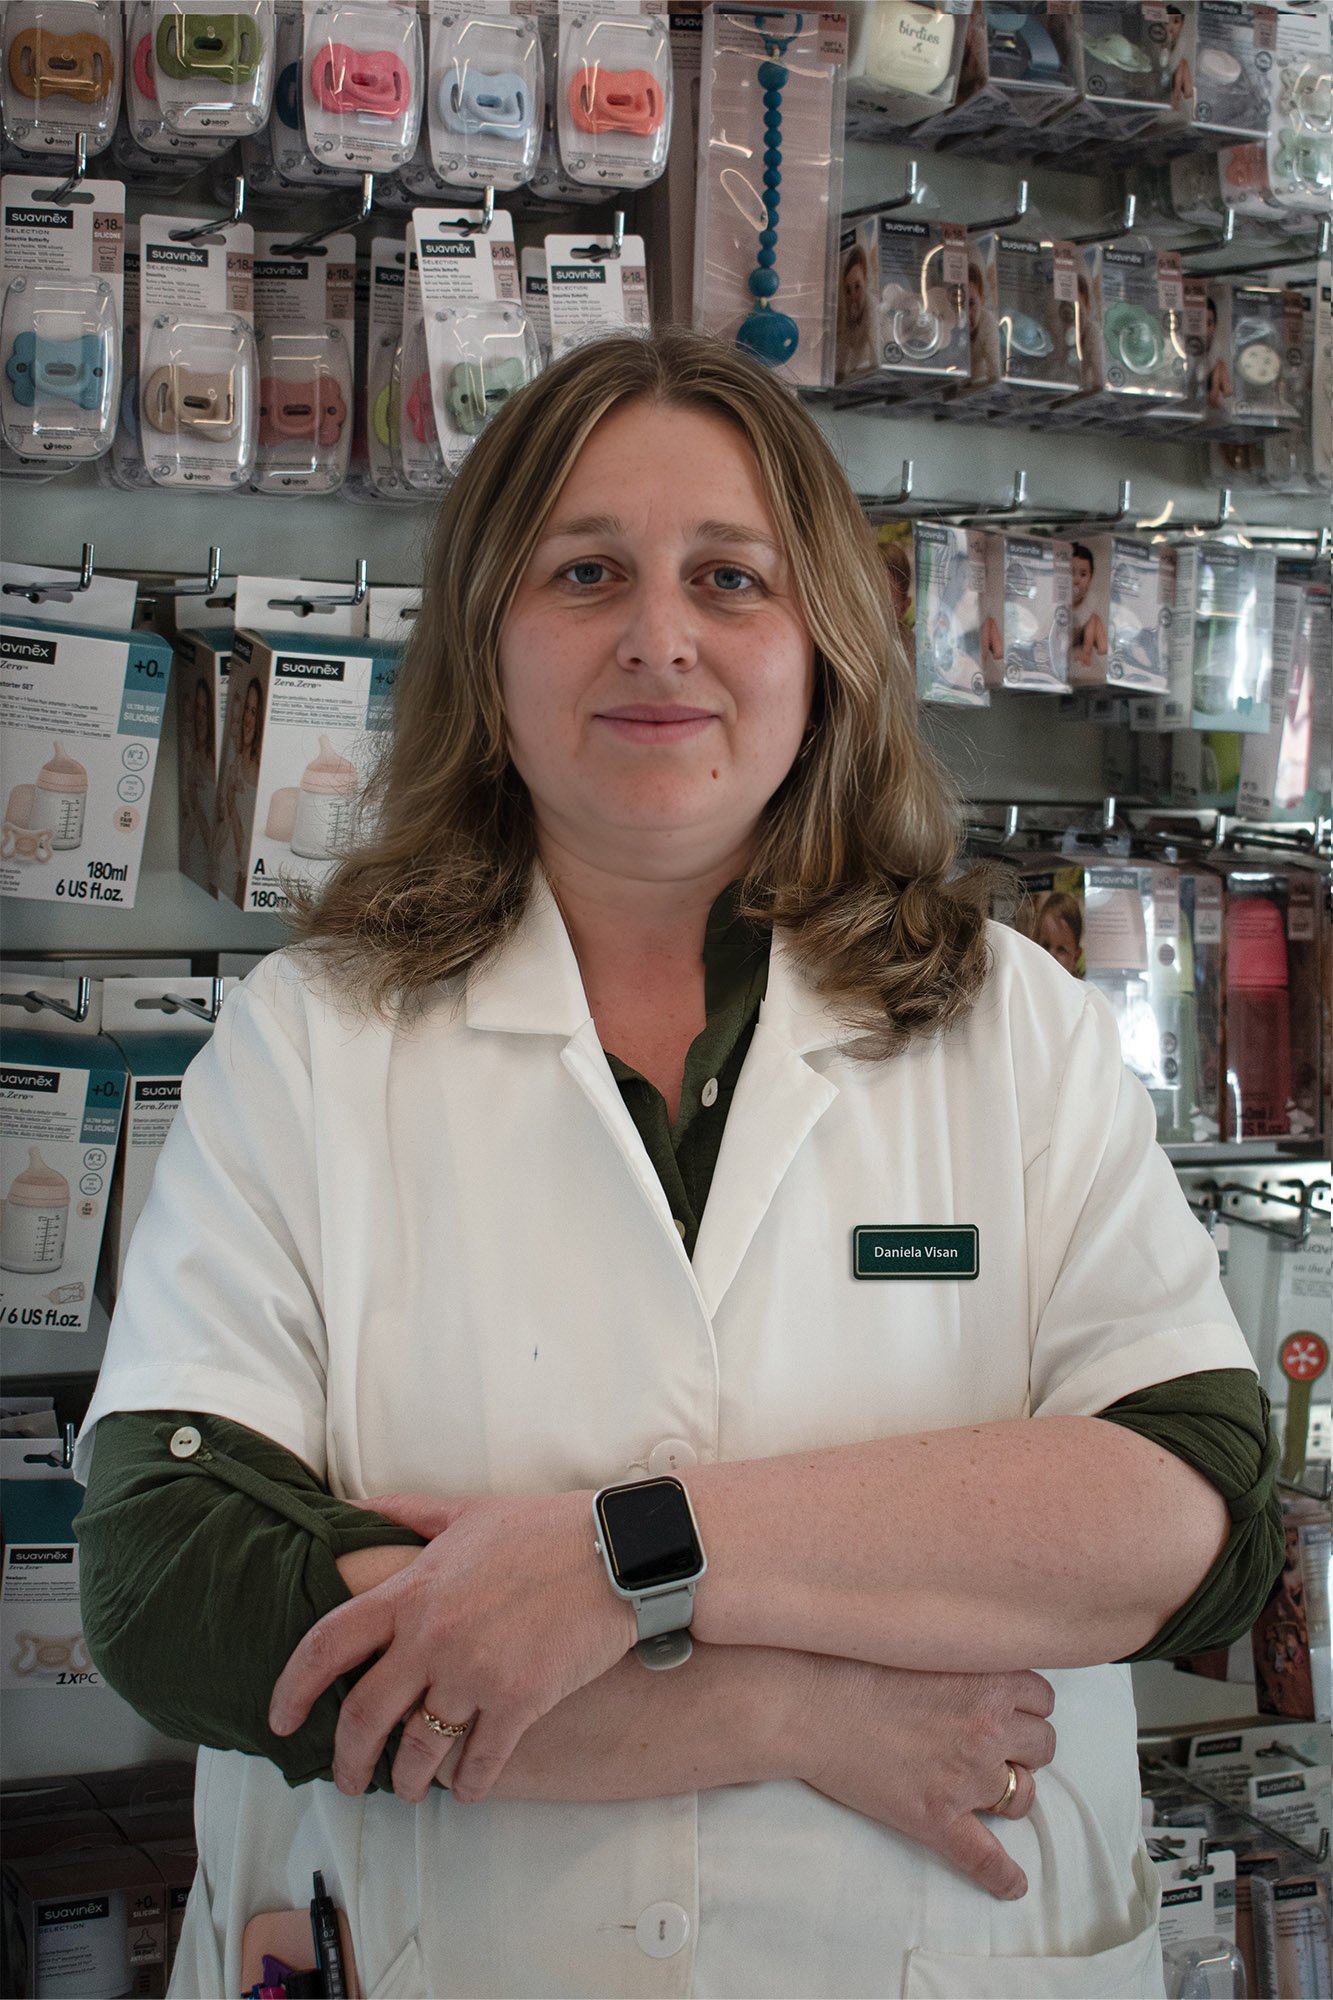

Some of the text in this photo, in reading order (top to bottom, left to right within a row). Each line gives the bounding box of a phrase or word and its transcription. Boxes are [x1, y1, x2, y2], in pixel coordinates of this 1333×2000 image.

[899, 20, 940, 44] birdies
[0, 642, 49, 658] avinēx
[123, 711, 160, 725] SILICONE
[87, 861, 128, 882] 180ml
[253, 858, 266, 875] A
[55, 879, 124, 902] 6 US fl.oz.
[250, 890, 293, 909] 180m
[0, 1075, 52, 1087] uavinēx
[83, 1125, 116, 1133] SILICONE
[874, 1246, 958, 1258] Daniela Visan
[7, 1308, 17, 1324] 6
[21, 1309, 43, 1326] US
[45, 1310, 82, 1327] fl.oz.
